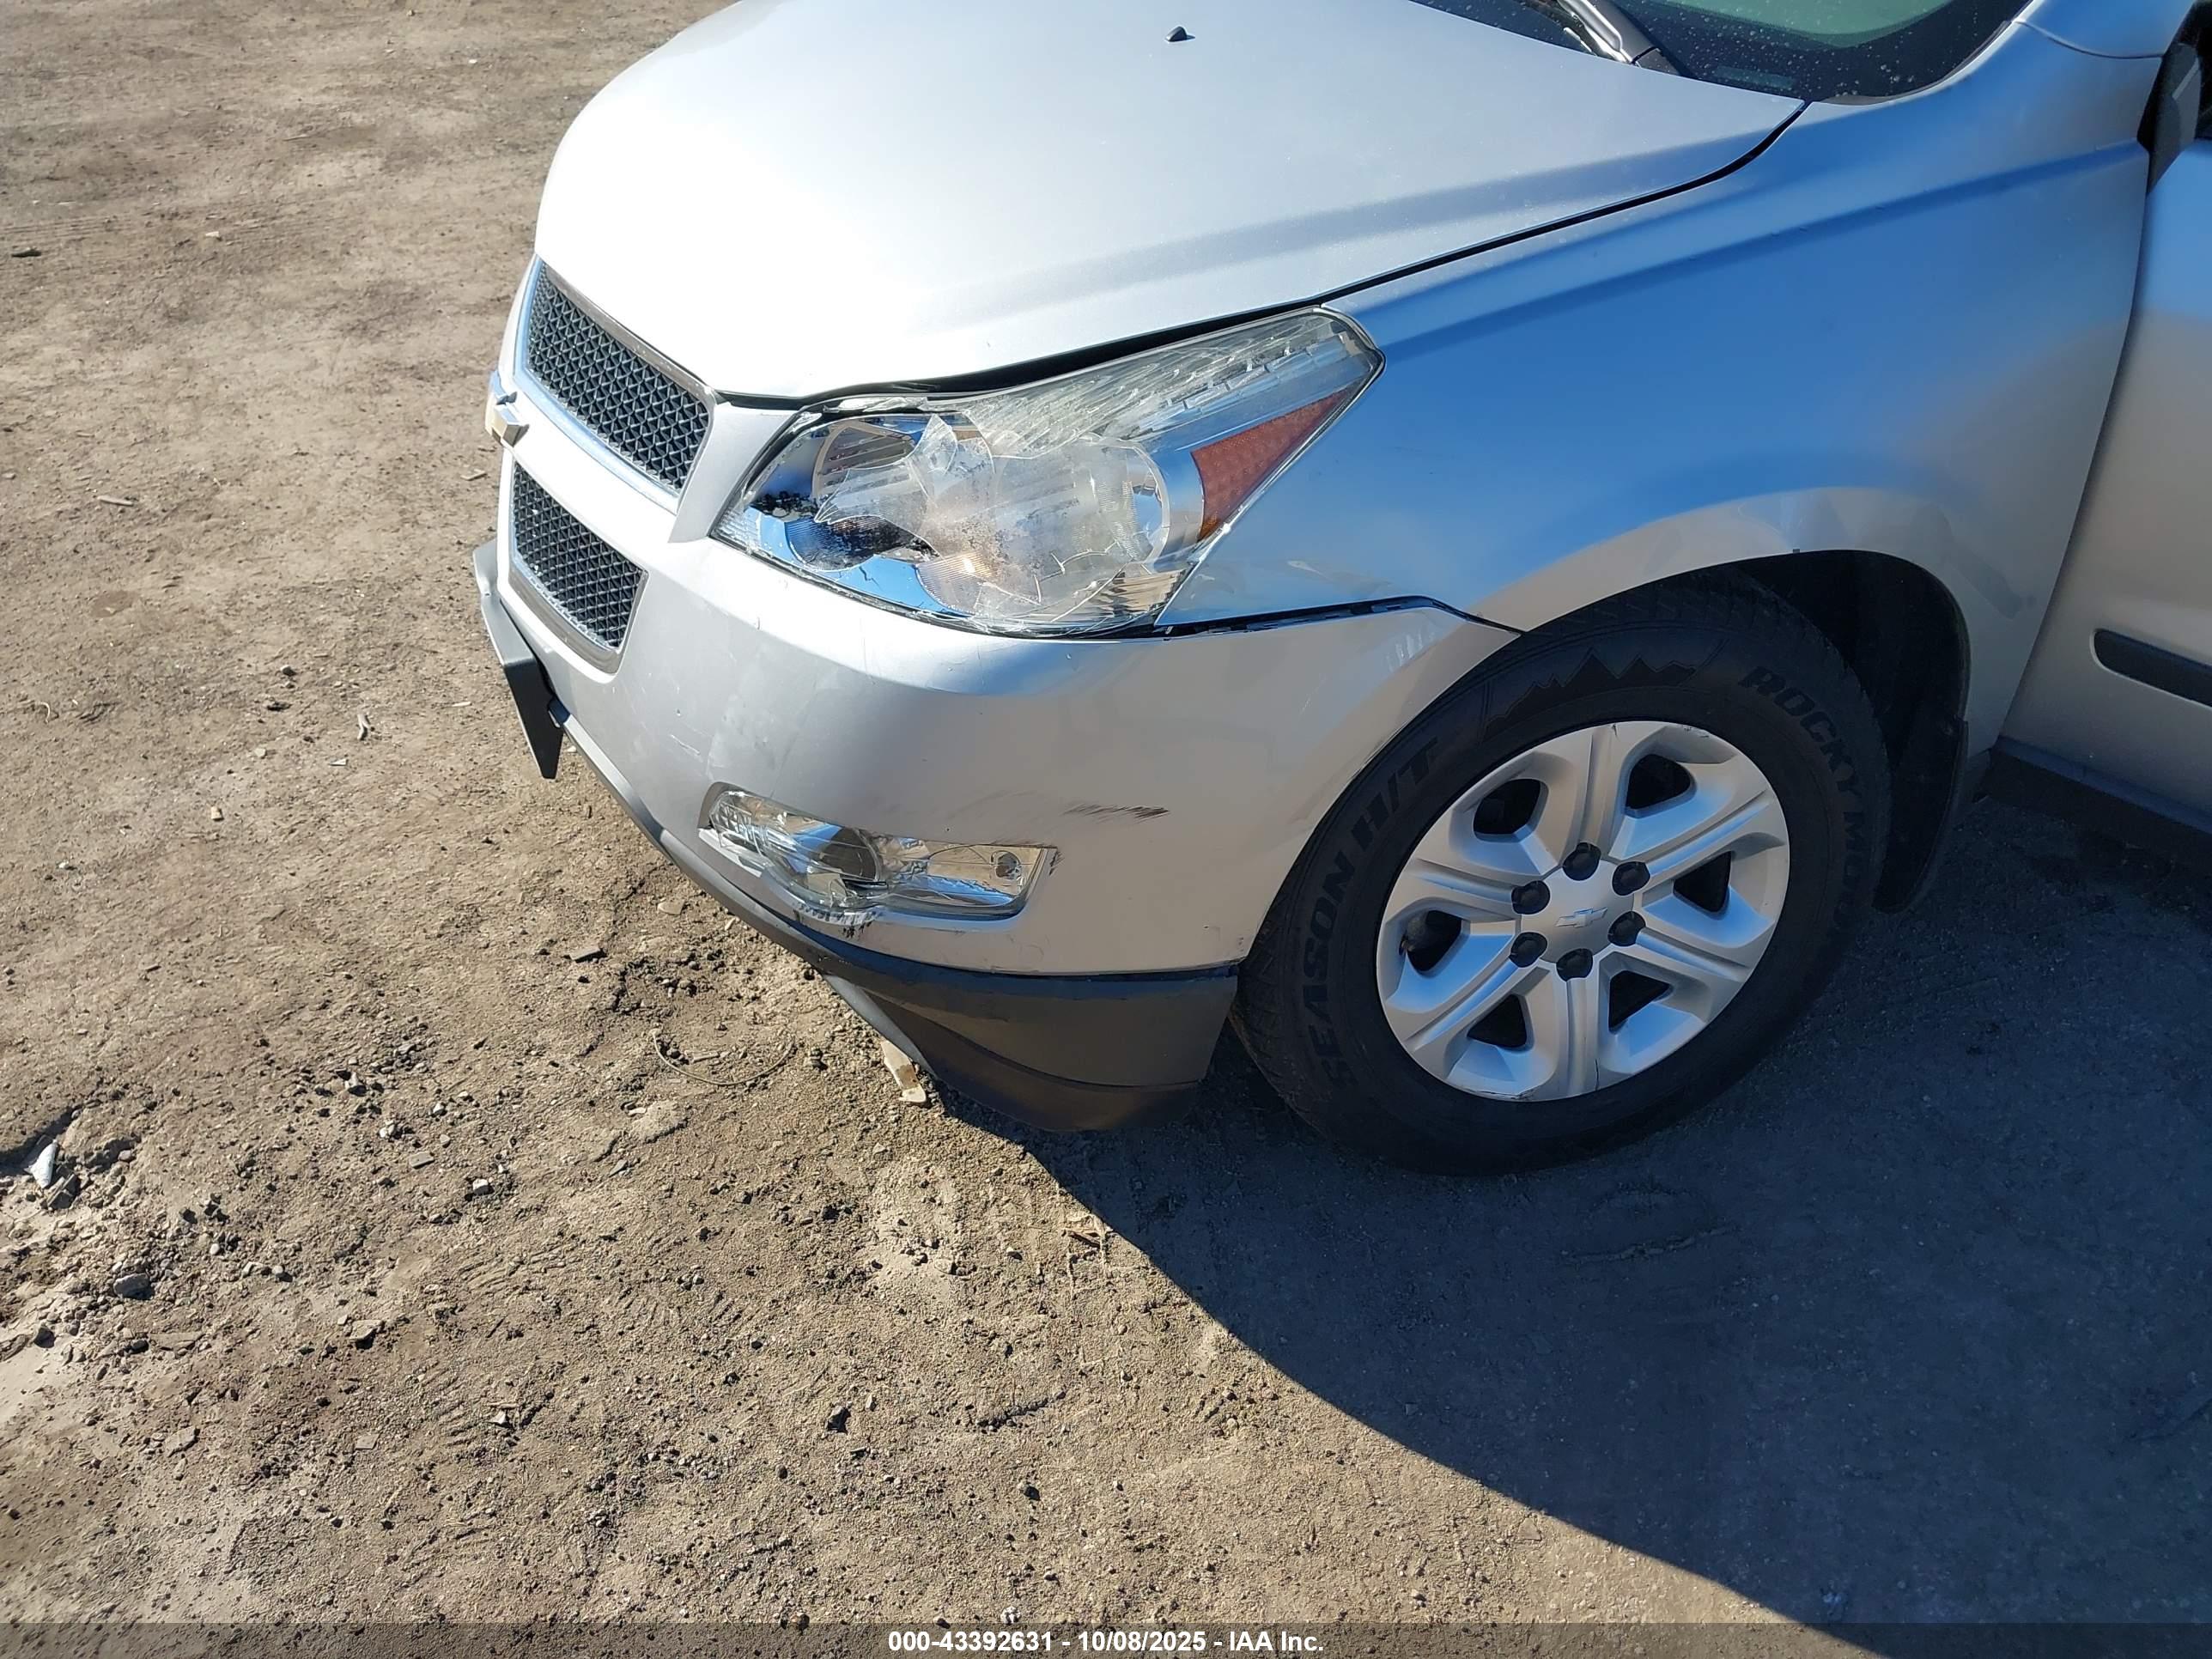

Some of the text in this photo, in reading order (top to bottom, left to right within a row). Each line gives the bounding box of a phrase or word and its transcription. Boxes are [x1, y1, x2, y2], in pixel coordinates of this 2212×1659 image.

[1738, 665, 1863, 799] ROCKY
[1302, 736, 1439, 1089] SEASON H/T
